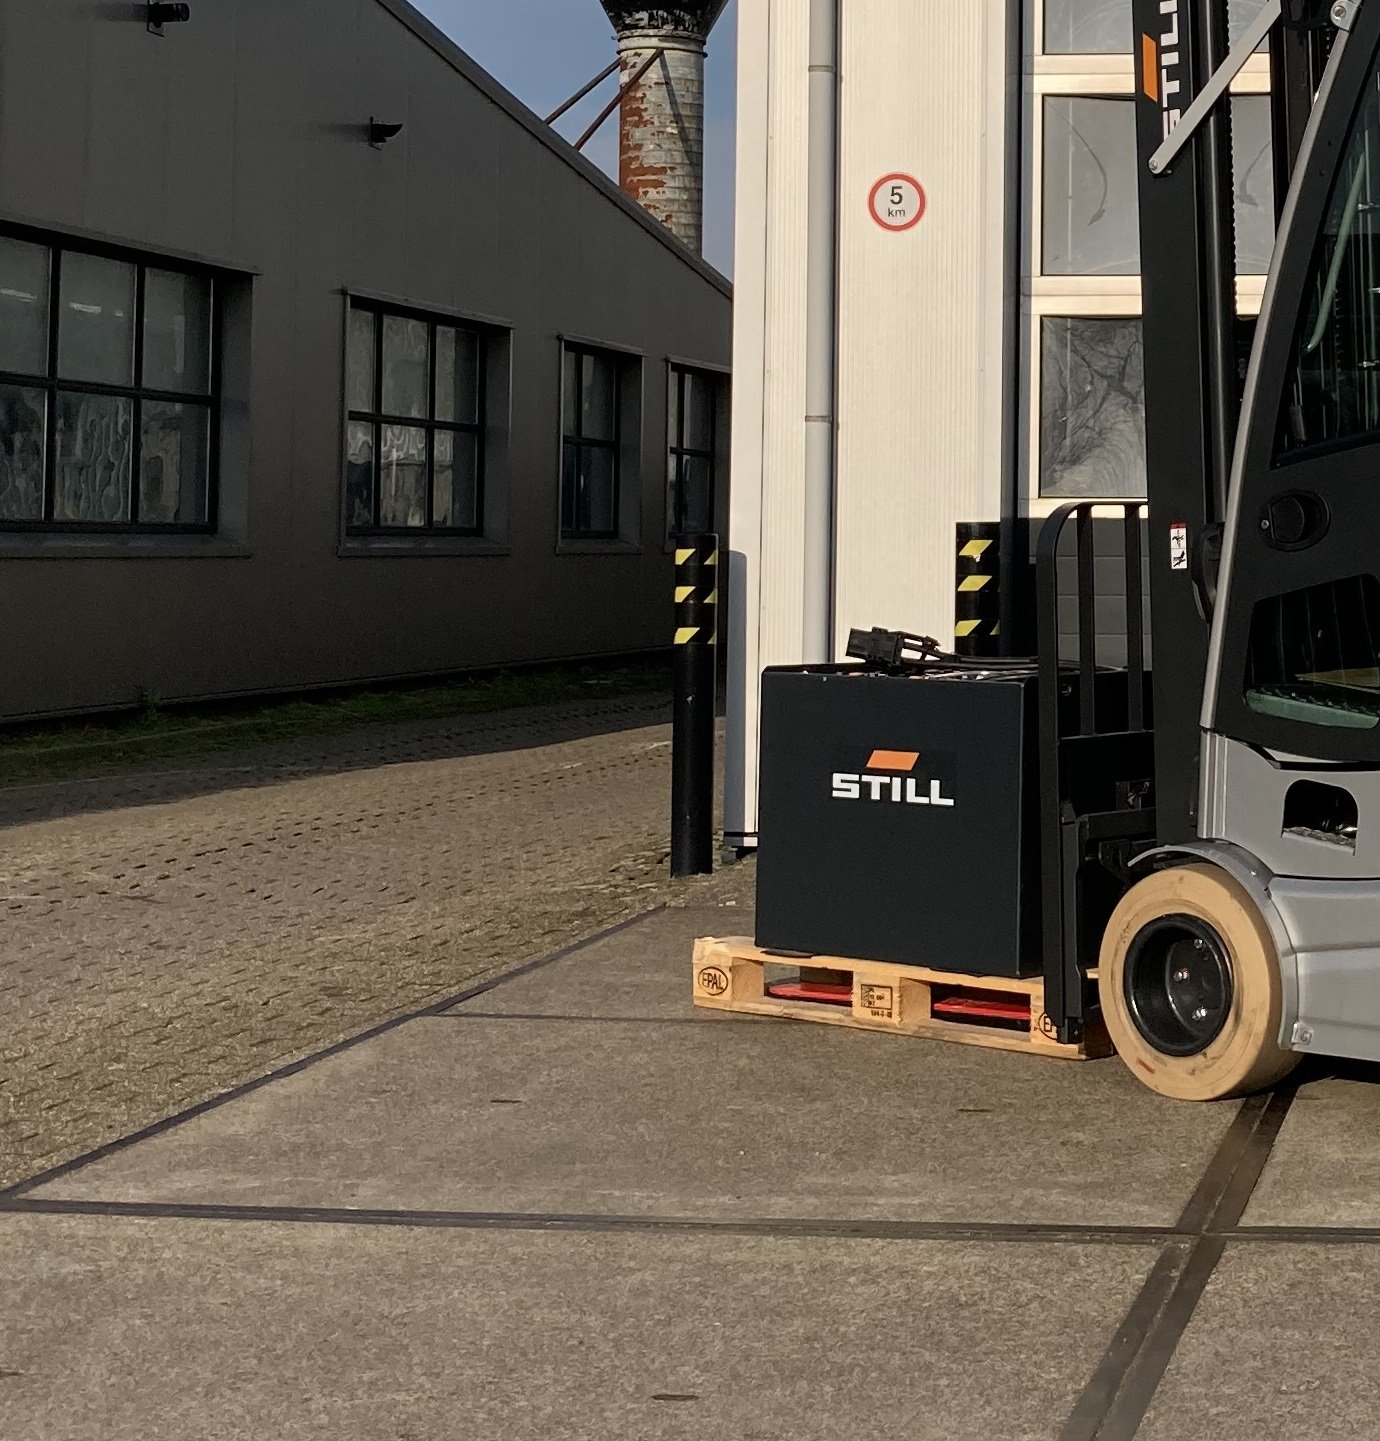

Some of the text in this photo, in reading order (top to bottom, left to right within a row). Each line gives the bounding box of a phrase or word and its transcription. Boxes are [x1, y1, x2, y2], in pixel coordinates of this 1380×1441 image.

[890, 186, 903, 205] 5
[888, 208, 906, 217] km
[832, 772, 954, 806] STILL
[702, 972, 724, 990] EPAL
